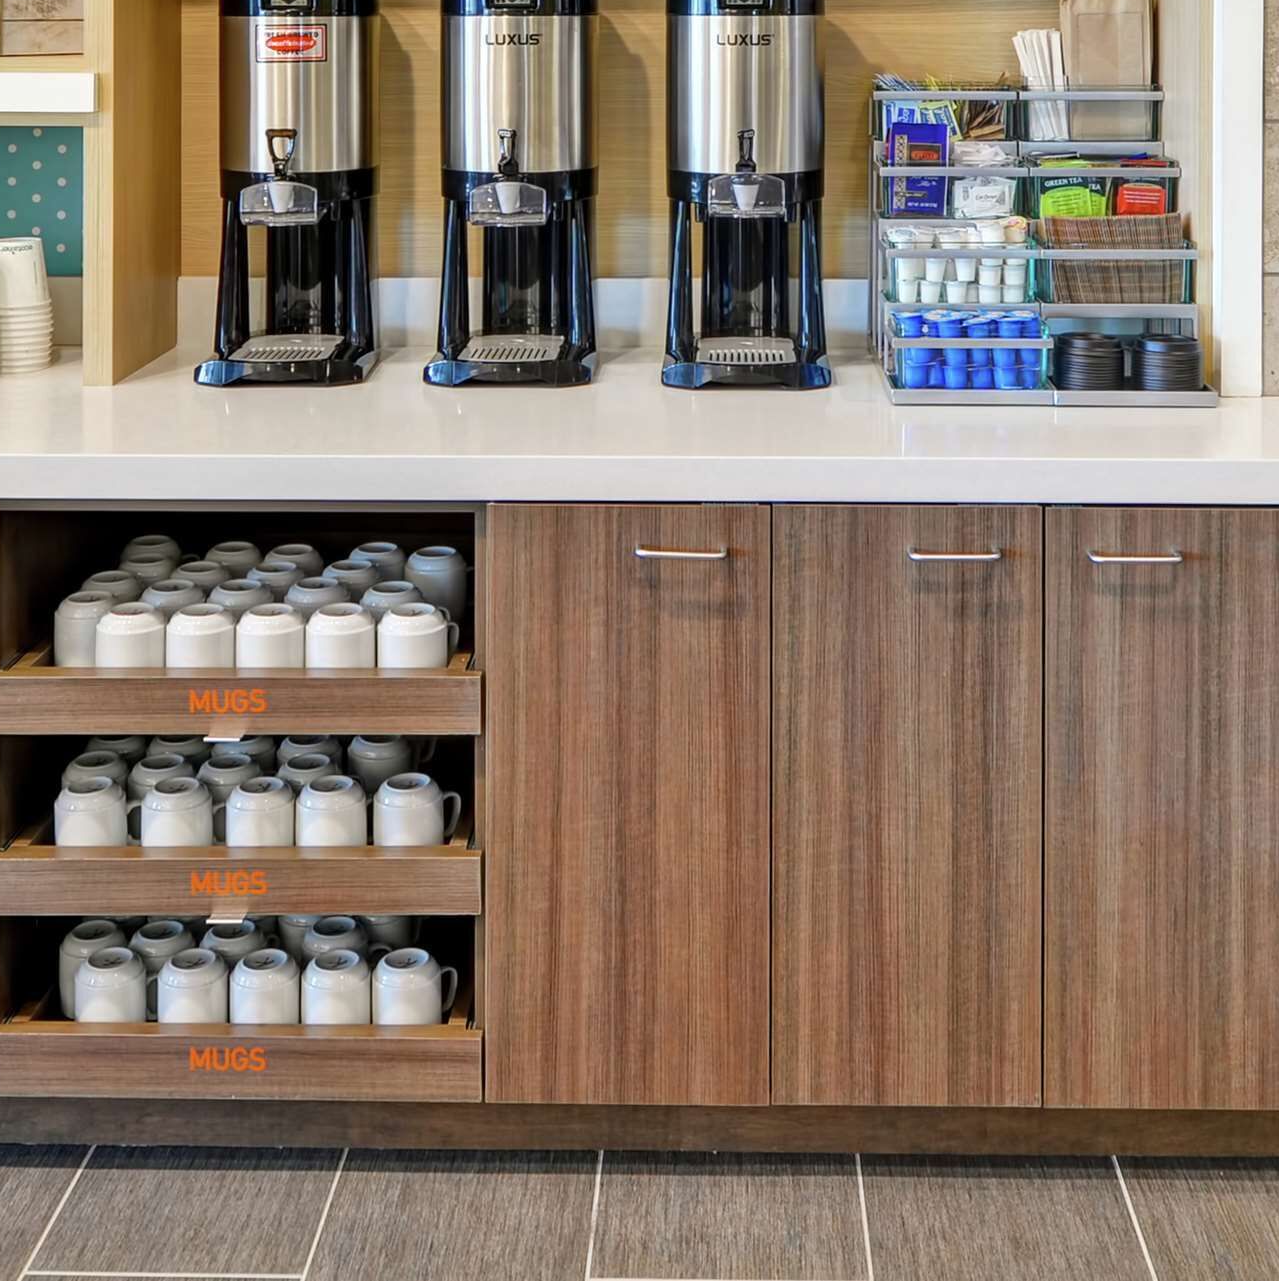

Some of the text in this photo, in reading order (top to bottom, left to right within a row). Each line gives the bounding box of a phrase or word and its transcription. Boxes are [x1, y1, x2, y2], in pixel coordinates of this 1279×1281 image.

[485, 33, 541, 46] LUXUS
[716, 34, 772, 46] LUXUS
[1044, 179, 1068, 187] GREEN
[1069, 177, 1083, 185] TEA
[188, 688, 268, 715] MUGS
[190, 870, 269, 896] MUGS
[188, 1046, 268, 1072] MUGS
